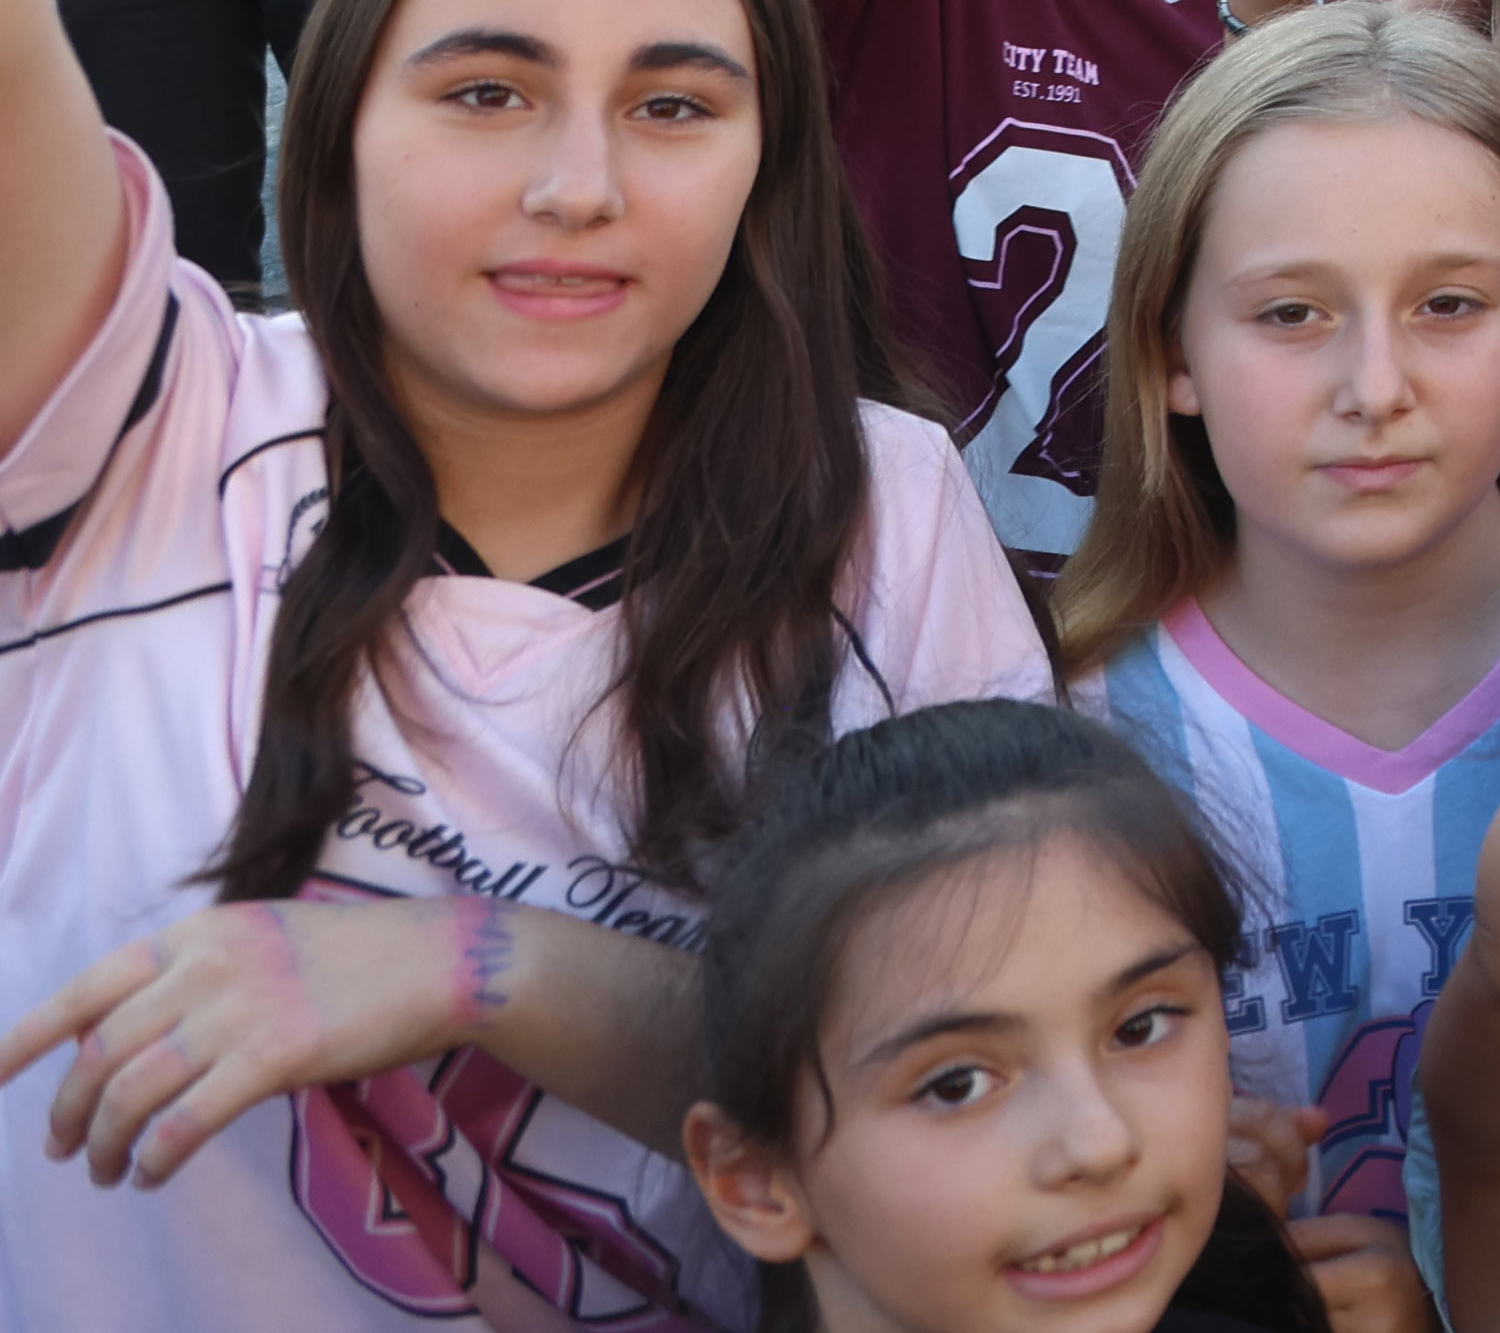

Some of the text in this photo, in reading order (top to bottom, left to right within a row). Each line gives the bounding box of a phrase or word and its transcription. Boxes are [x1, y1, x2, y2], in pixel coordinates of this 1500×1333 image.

[1002, 40, 1100, 86] CITY TEAM
[1012, 80, 1083, 104] EST.1991
[1222, 909, 1361, 1037] EW
